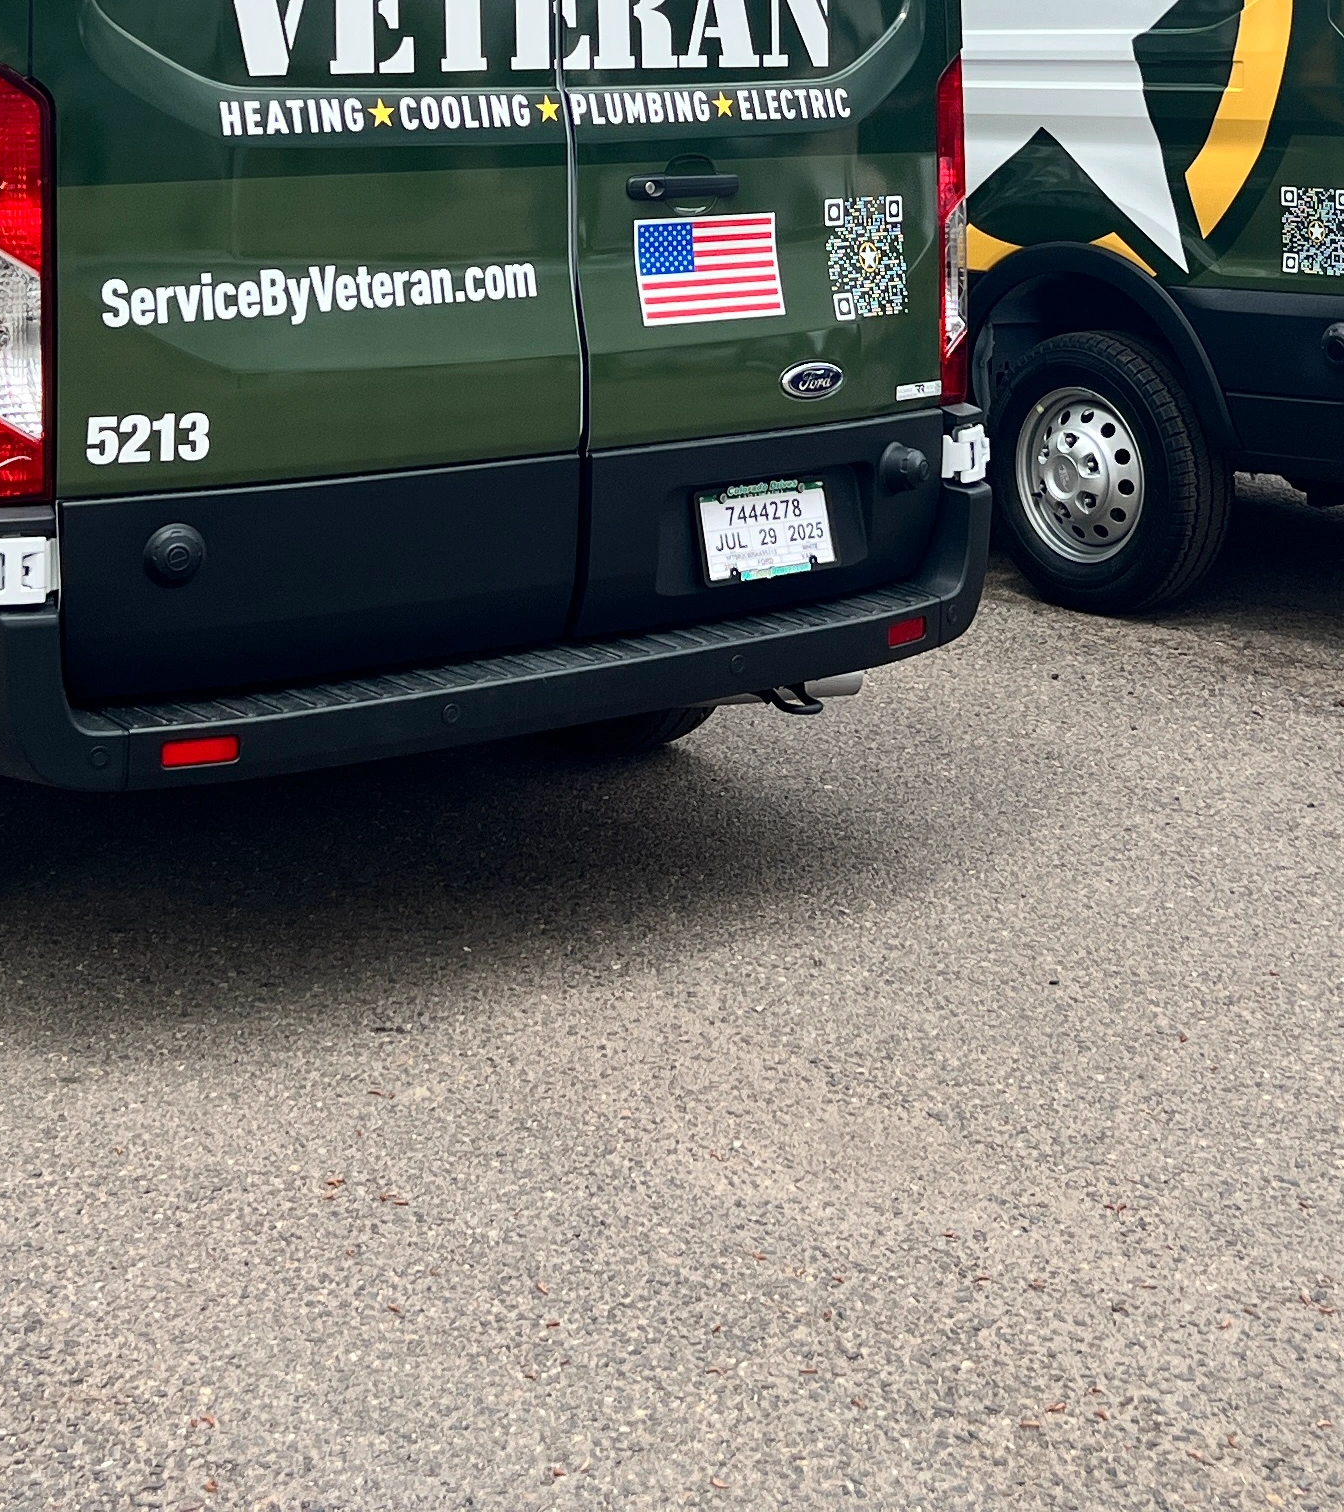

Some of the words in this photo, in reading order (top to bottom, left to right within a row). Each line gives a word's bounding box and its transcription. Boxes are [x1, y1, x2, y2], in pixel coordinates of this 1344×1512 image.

[219, 98, 366, 136] HEATING
[399, 94, 532, 131] COOLING
[571, 90, 711, 126] PLUMBING
[738, 87, 852, 121] ELECTRIC
[100, 262, 538, 328] ServiceByVeteran.com
[798, 369, 833, 391] Ford
[86, 412, 210, 465] 5213
[727, 482, 769, 496] Colorado
[769, 479, 798, 492] Drives
[725, 498, 802, 526] 7444278
[716, 531, 748, 551] JUL
[759, 528, 777, 545] 29
[788, 521, 824, 542] 2025
